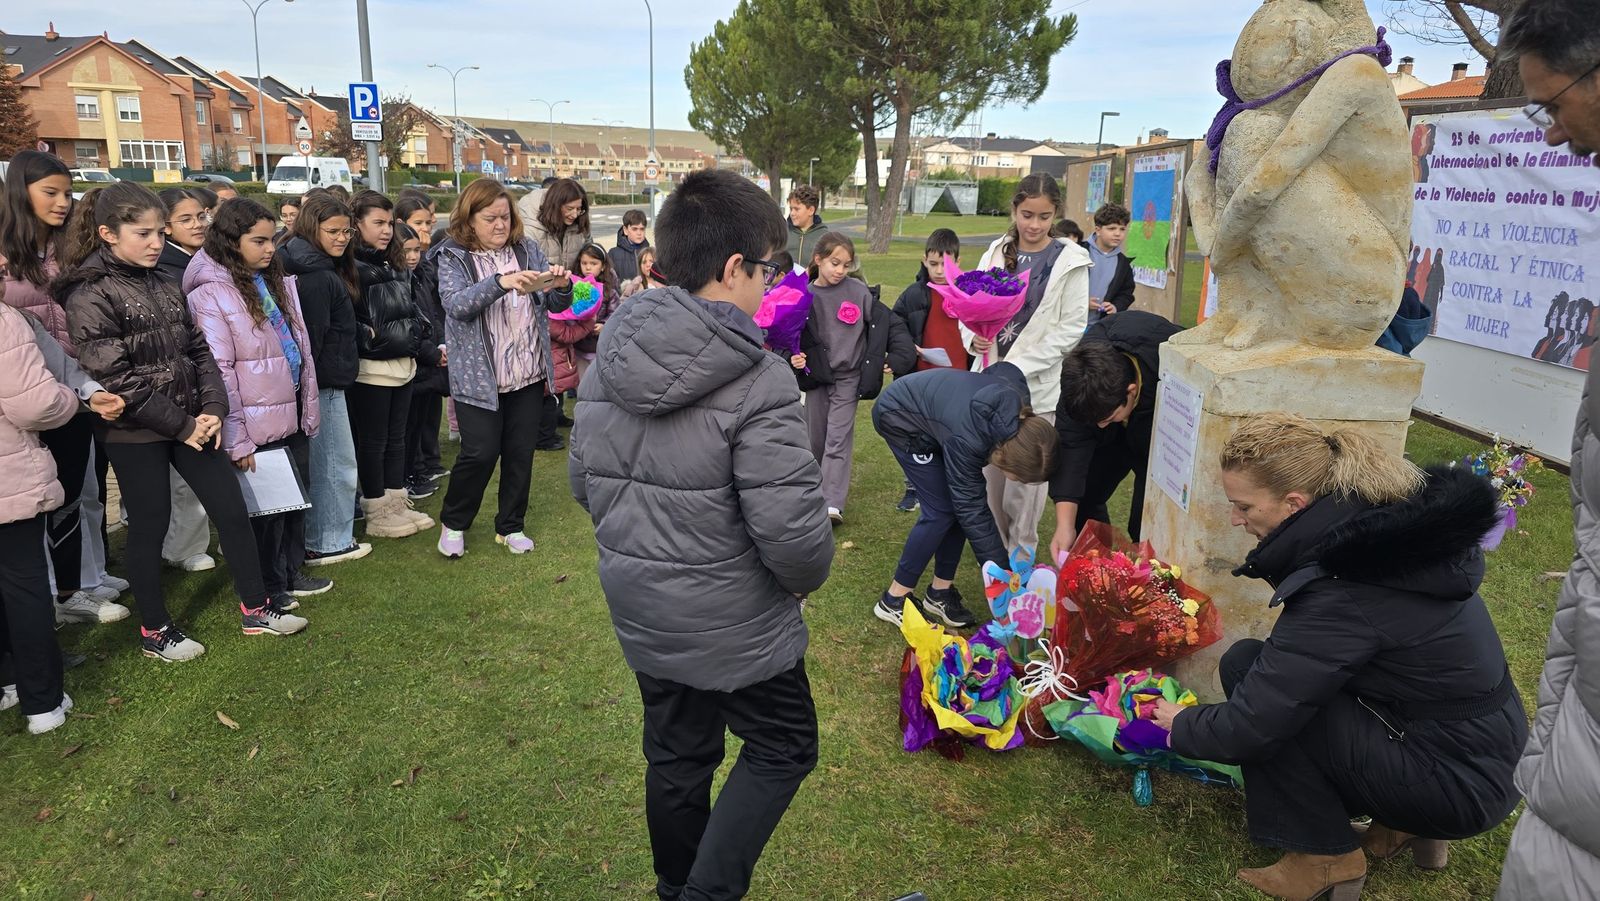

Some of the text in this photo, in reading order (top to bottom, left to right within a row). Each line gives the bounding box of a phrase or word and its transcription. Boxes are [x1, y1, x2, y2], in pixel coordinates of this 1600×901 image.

[354, 86, 374, 117] P
[1452, 132, 1463, 146] 25
[1468, 131, 1480, 145] de
[1430, 151, 1592, 169] Internacional de la Elimina
[1414, 187, 1600, 212] de la Violencia contra la Muj
[1435, 220, 1578, 247] NO A LA VIOLENCIA
[1449, 250, 1585, 283] RACIAL Y ÉTNICA
[1452, 281, 1533, 309] CONTRA LA
[1465, 314, 1510, 339] MUJER
